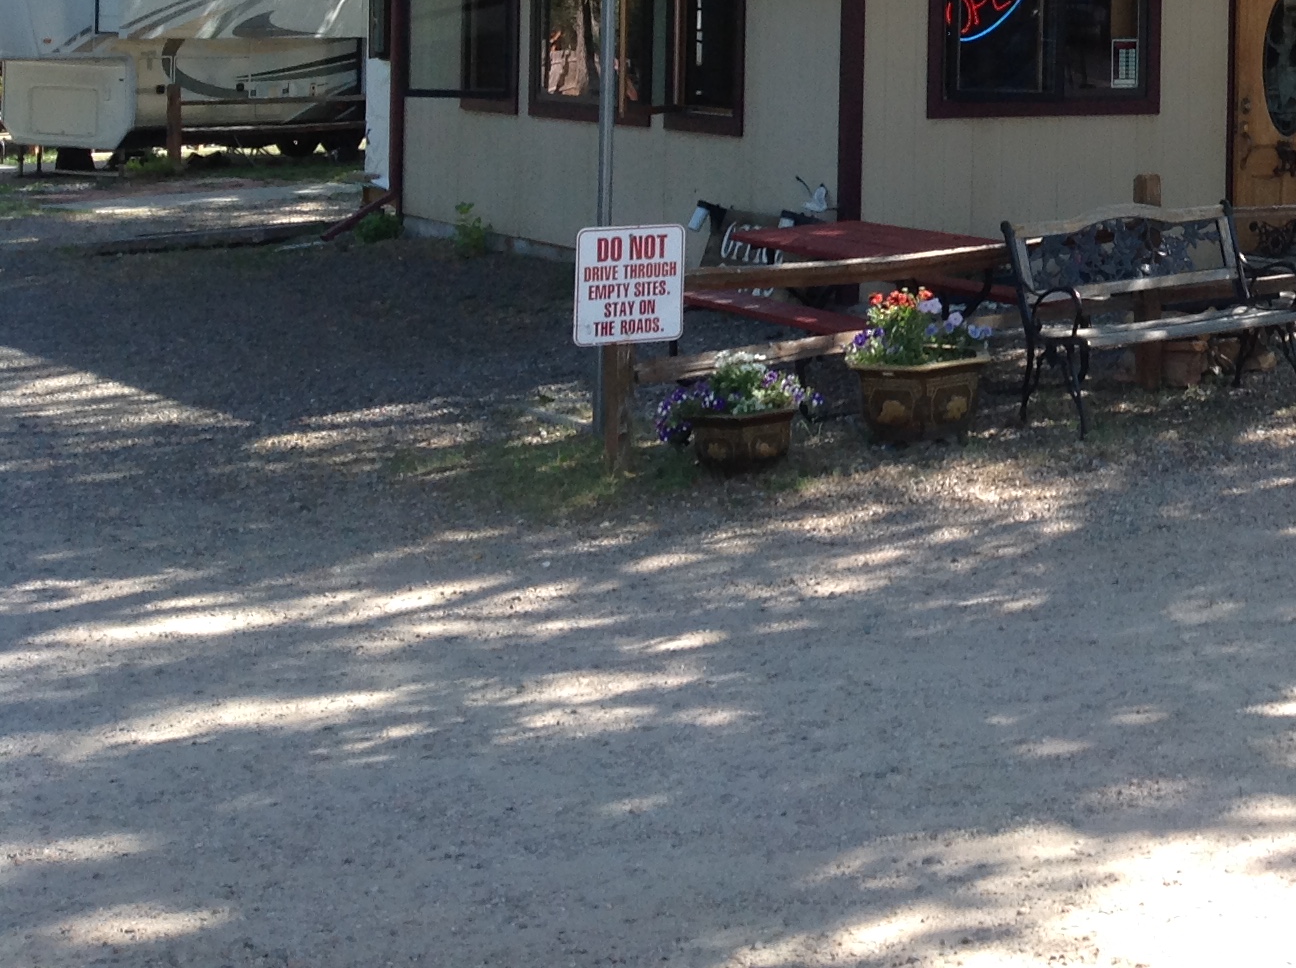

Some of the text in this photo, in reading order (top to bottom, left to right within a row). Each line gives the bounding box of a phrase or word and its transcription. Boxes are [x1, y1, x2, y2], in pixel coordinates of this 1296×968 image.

[597, 234, 668, 263] DO NOT
[584, 261, 677, 282] DRIVE THROUGH
[588, 280, 670, 301] EMPTY SITES.
[604, 299, 655, 318] STAY ON
[593, 317, 664, 337] THE ROADS.
